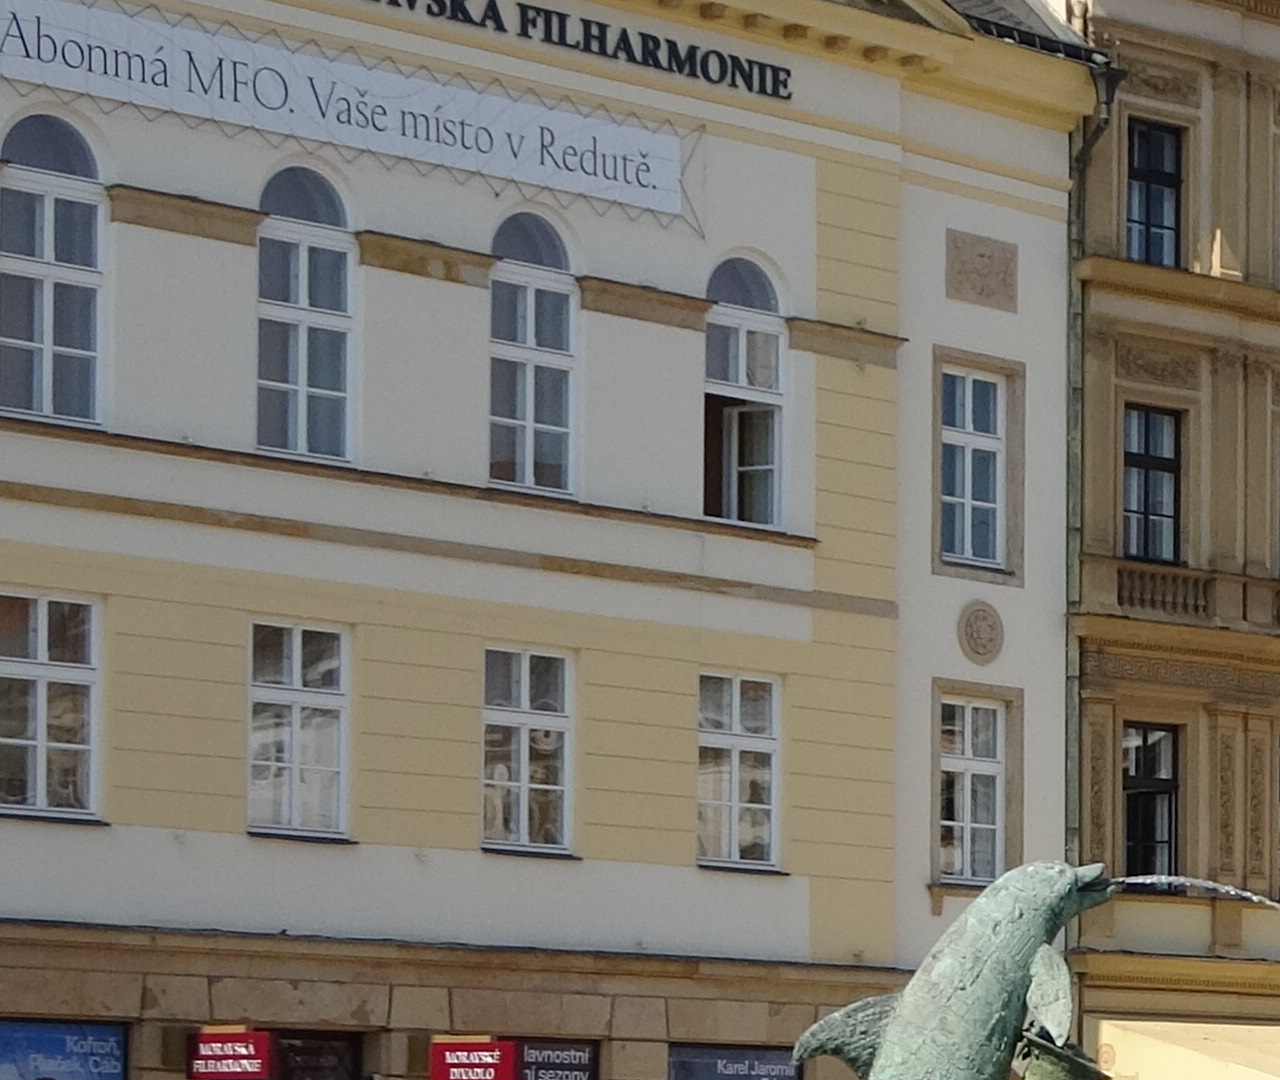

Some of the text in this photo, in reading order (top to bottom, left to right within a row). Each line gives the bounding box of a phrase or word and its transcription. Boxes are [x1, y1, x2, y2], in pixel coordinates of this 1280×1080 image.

[516, 2, 793, 101] FILHARMONIE
[0, 11, 657, 190] Abonmá MFO. Vaše místo v Redutě.
[444, 1049, 501, 1064] MORAVSKÉ
[523, 1045, 590, 1065] lavnostní
[193, 1059, 261, 1073] FILHARMONIE
[449, 1068, 495, 1080] DIVADLO
[717, 1059, 749, 1075] Karel
